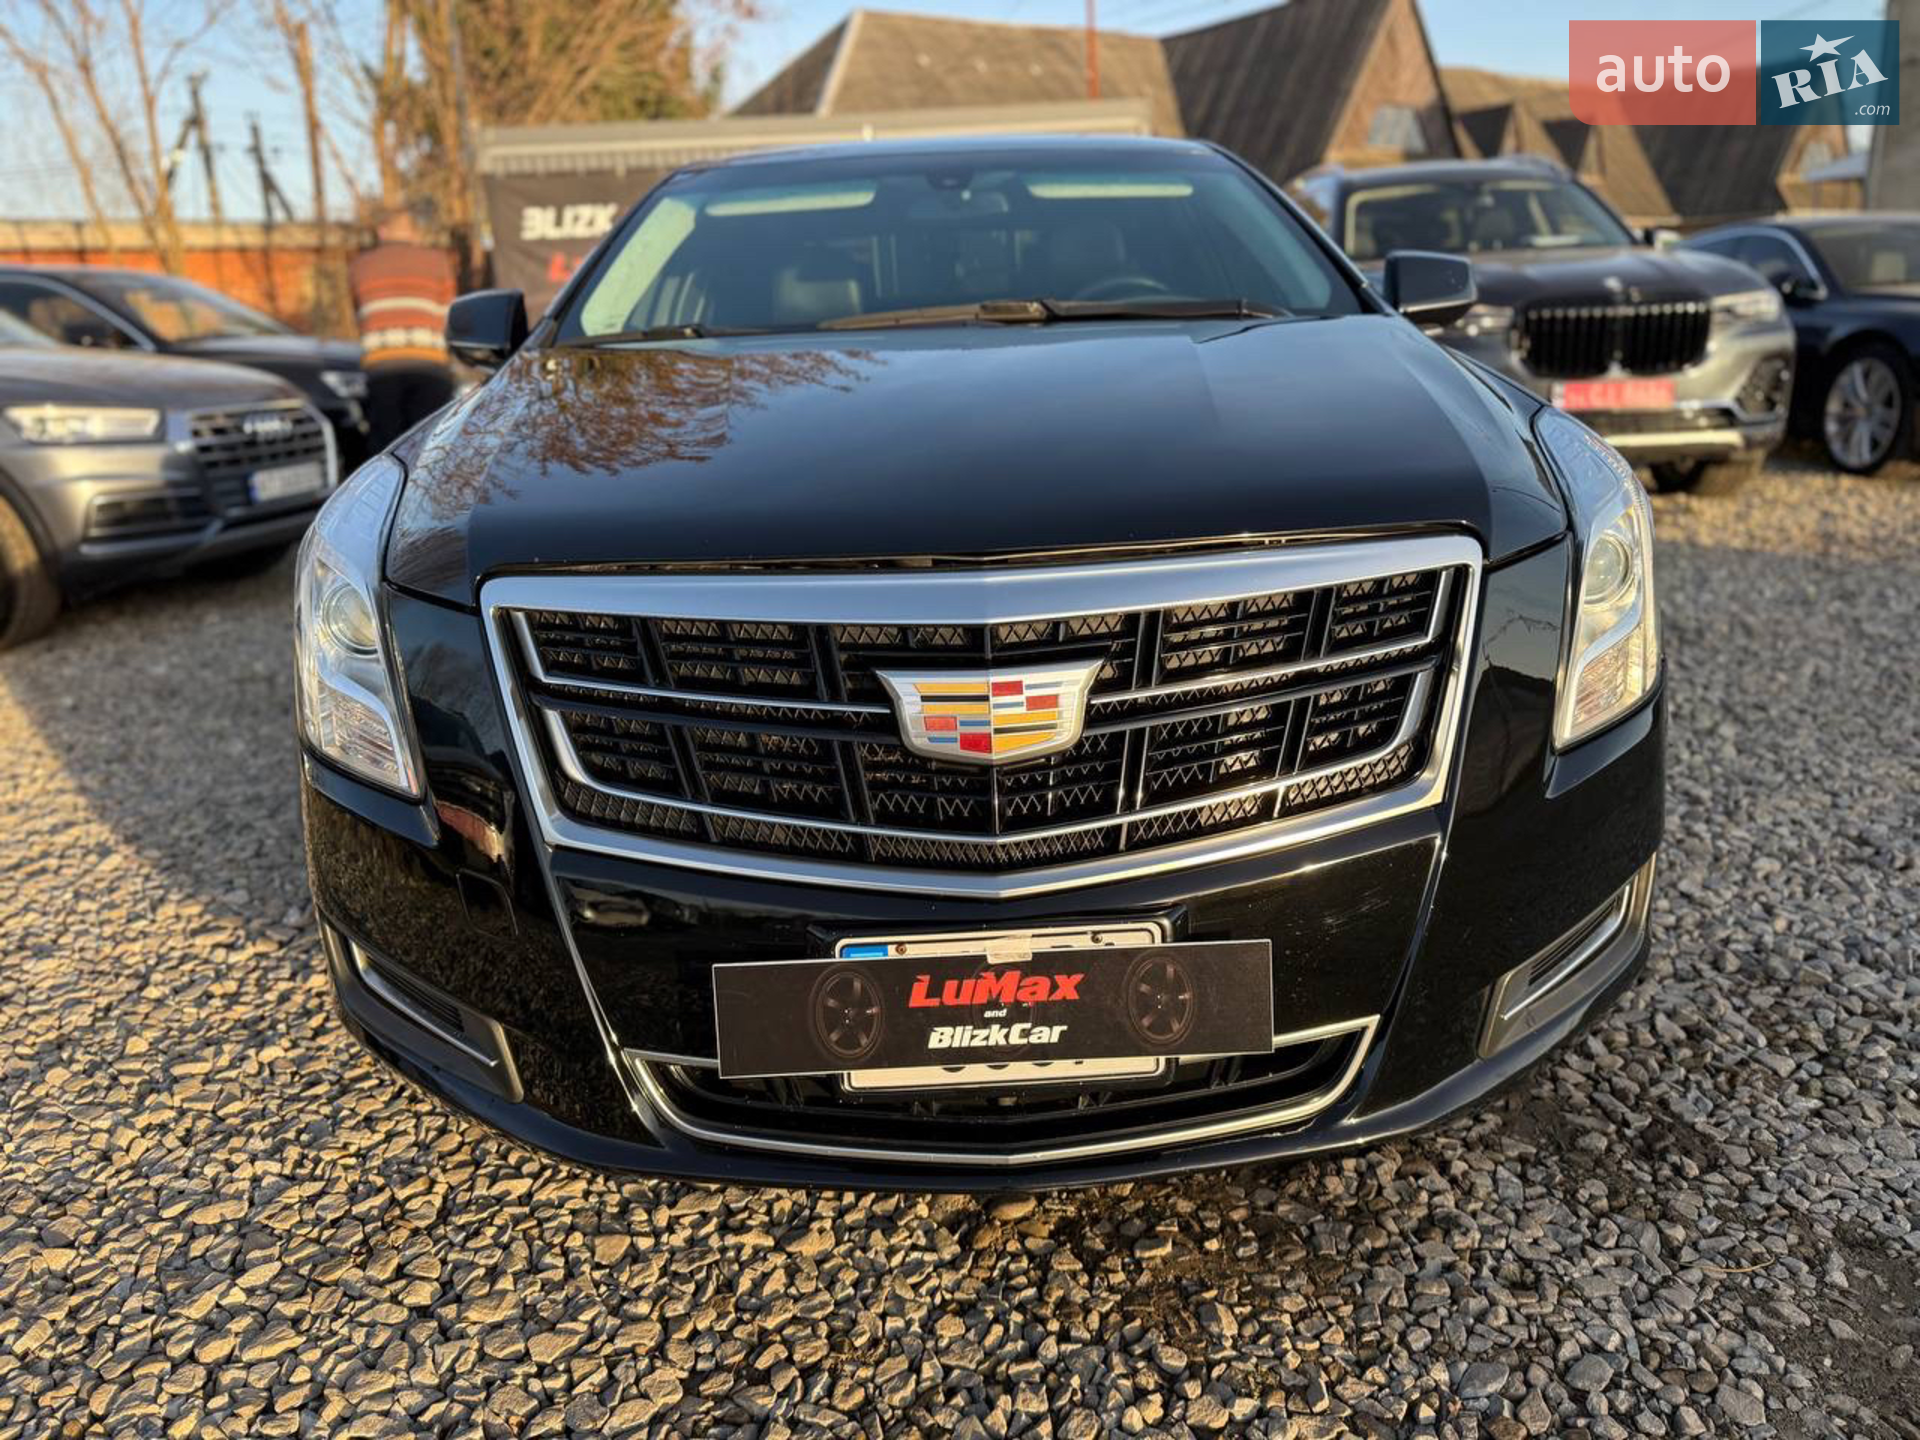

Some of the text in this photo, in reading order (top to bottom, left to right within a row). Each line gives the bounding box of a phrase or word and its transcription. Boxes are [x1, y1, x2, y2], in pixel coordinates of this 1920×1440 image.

[908, 970, 1085, 1008] LuMax
[983, 1008, 1007, 1018] and
[927, 1023, 1068, 1050] BlizkCar
